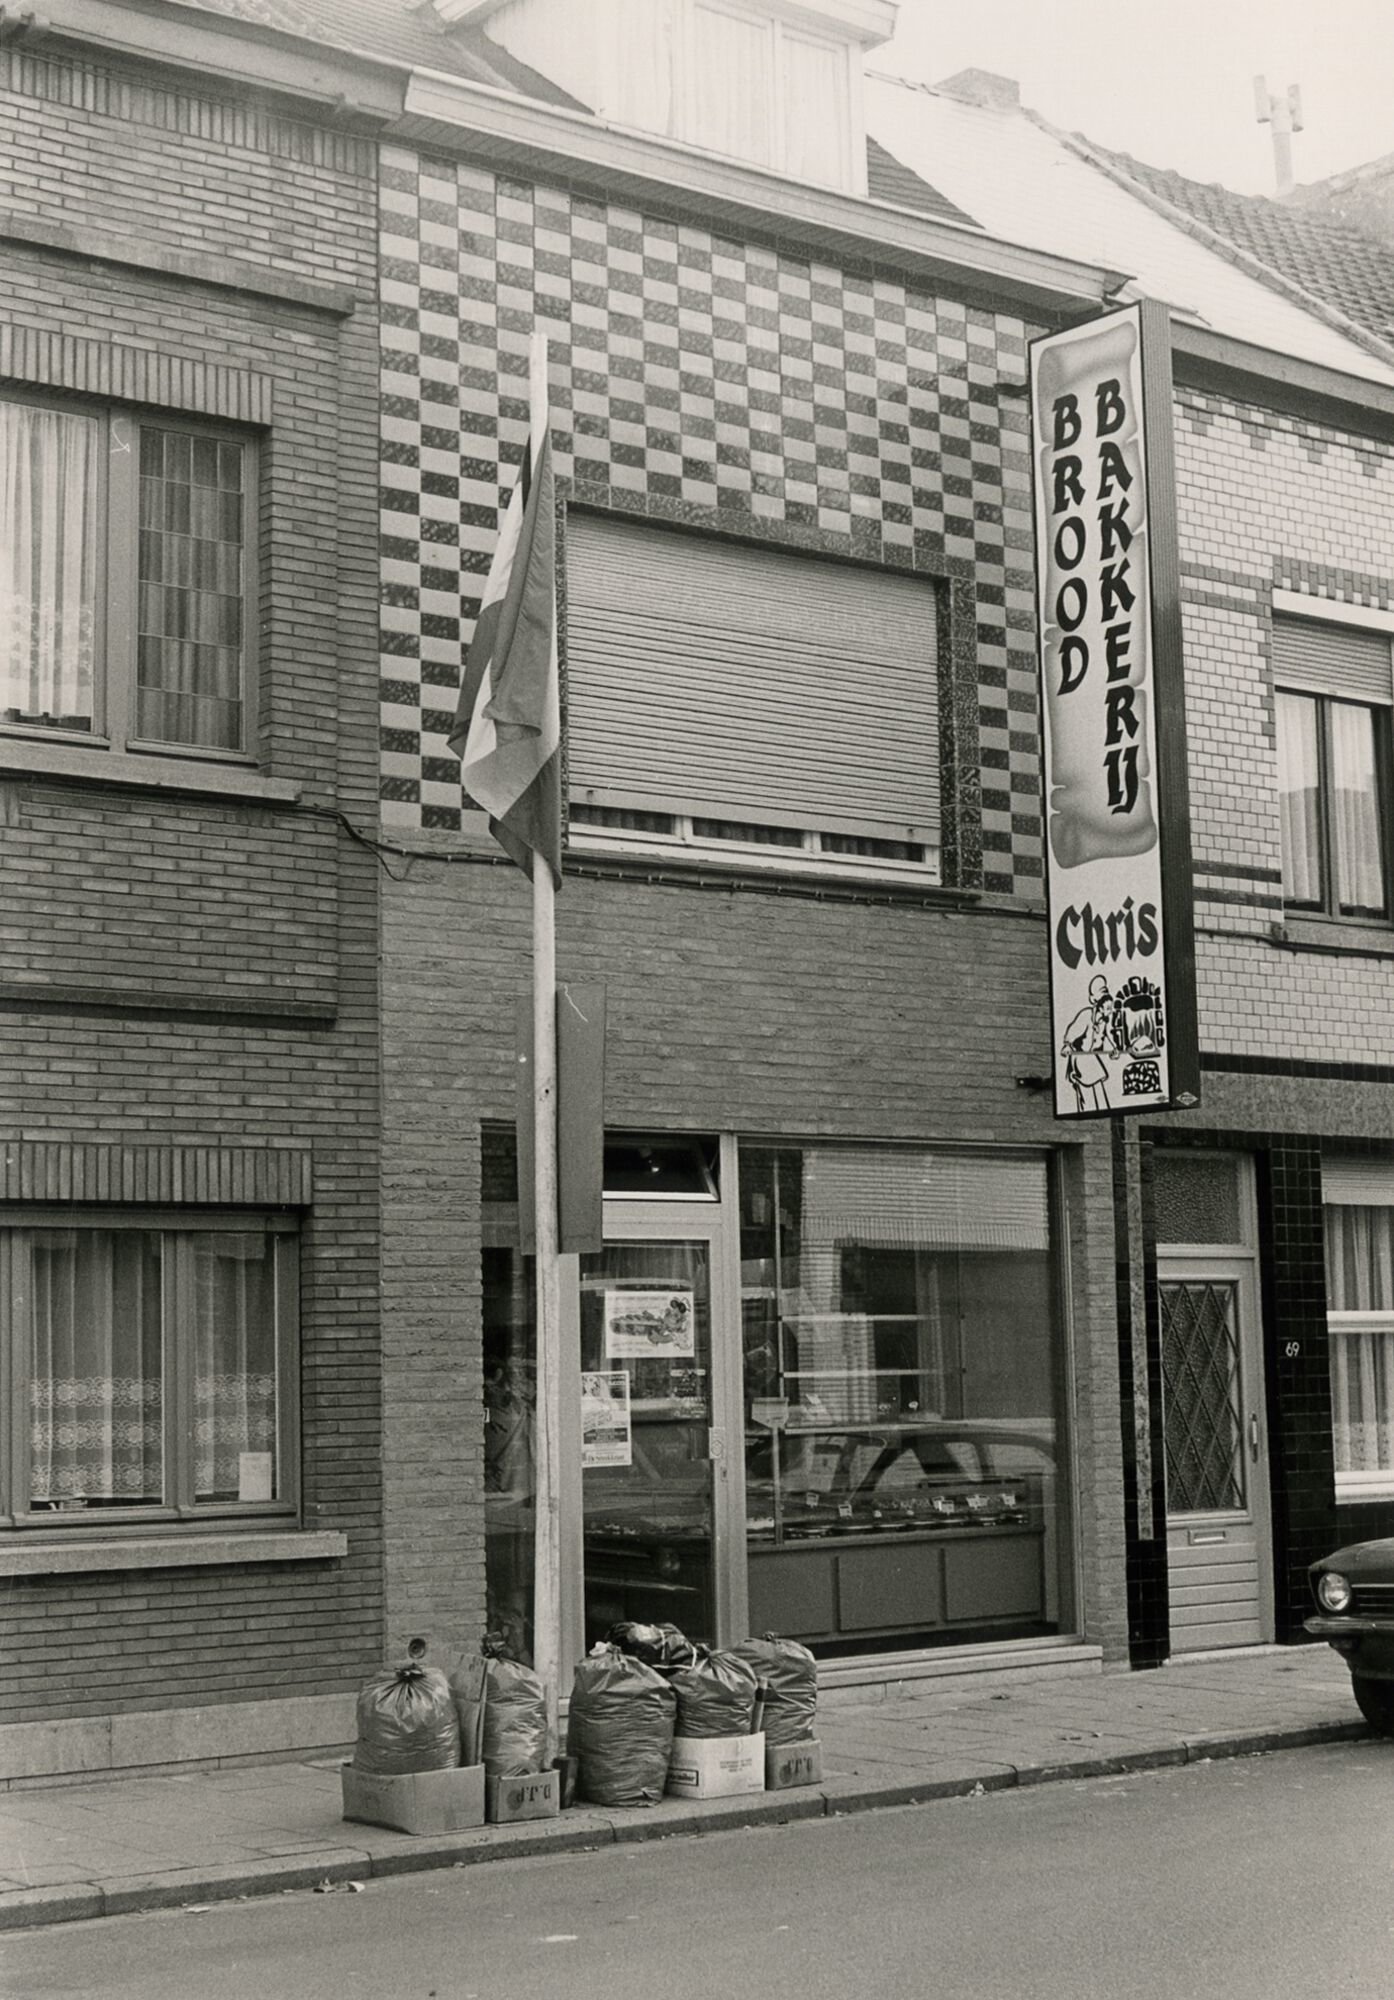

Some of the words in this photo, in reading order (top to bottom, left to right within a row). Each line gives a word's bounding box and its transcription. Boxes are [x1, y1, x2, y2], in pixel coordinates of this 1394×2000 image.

[1052, 393, 1090, 697] BROOD
[1095, 377, 1140, 816] BAKKERIJ
[1056, 895, 1159, 970] Chris
[1285, 1341, 1300, 1357] 69
